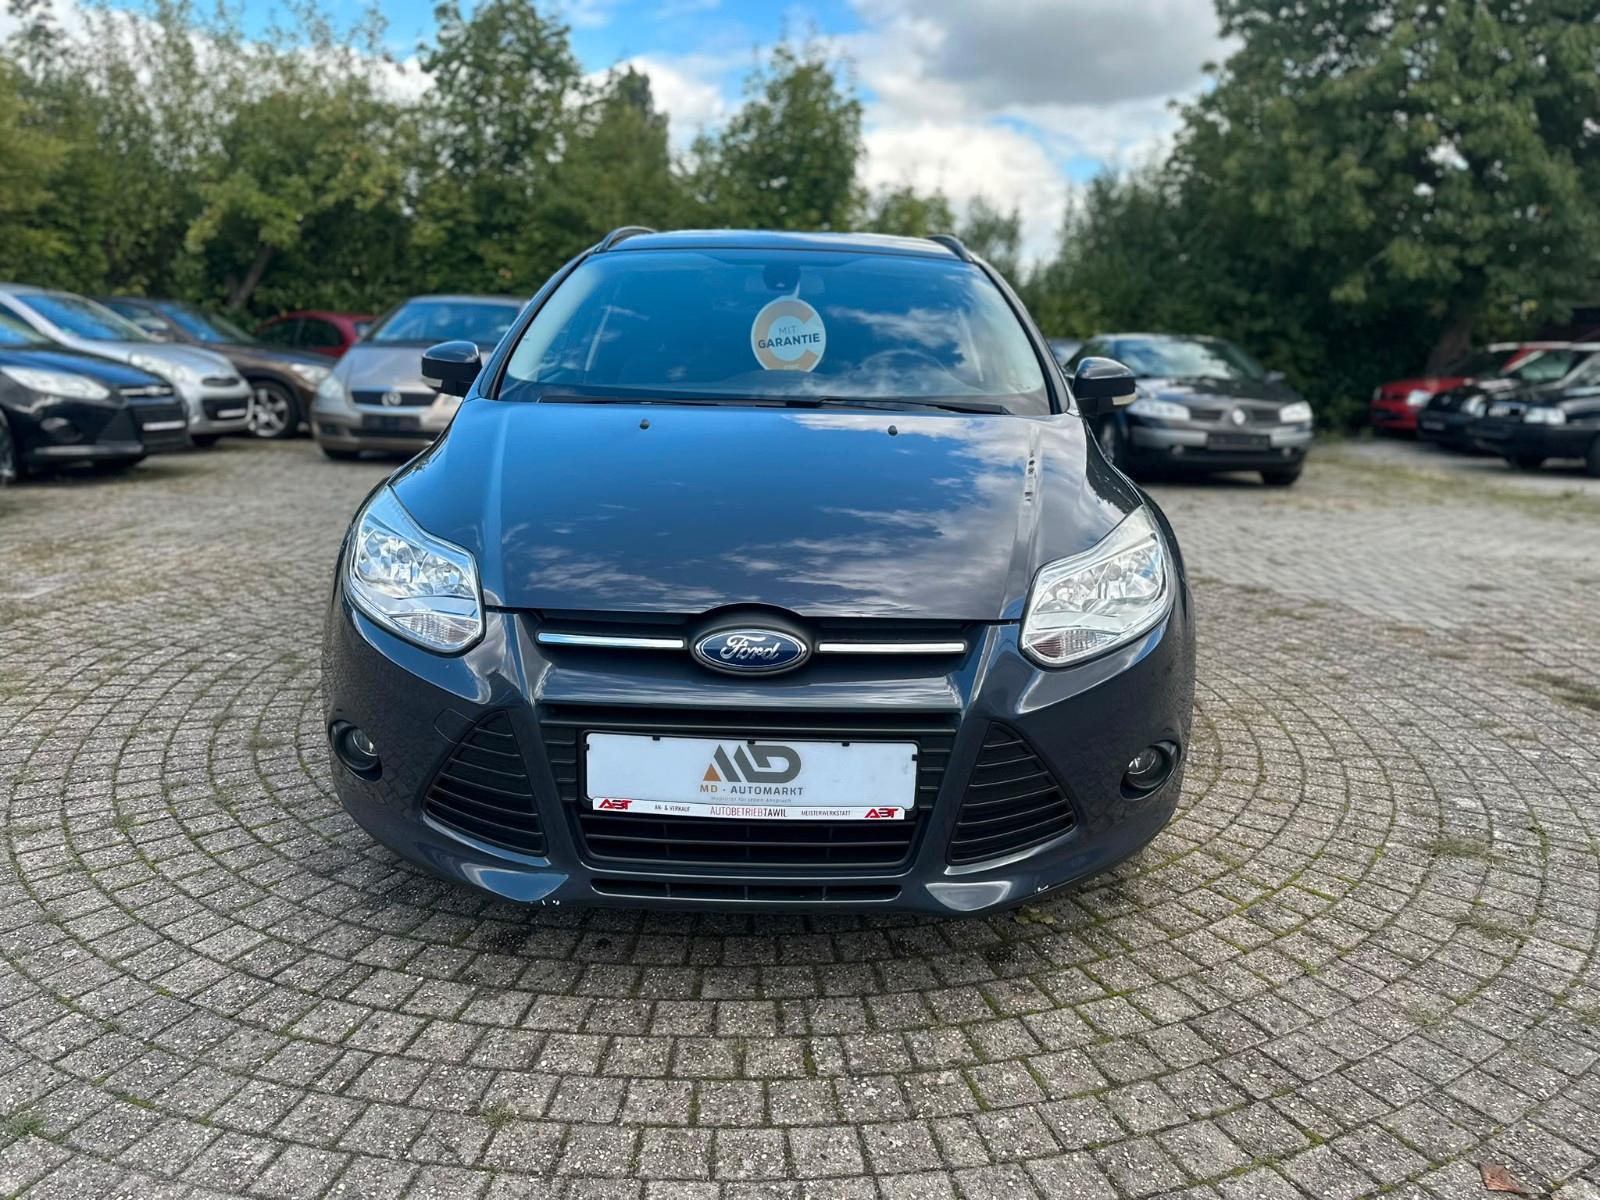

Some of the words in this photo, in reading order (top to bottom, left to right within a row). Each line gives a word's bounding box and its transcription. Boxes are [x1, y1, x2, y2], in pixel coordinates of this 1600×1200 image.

[778, 325, 796, 336] MIT
[758, 332, 821, 349] GARANTIE
[719, 634, 781, 660] Ford
[699, 784, 718, 793] MD
[730, 785, 804, 796] AUTOMARKT
[710, 806, 788, 817] AUTOBETRIEBTAWIL
[800, 809, 851, 817] MEISTERWERKSTATT
